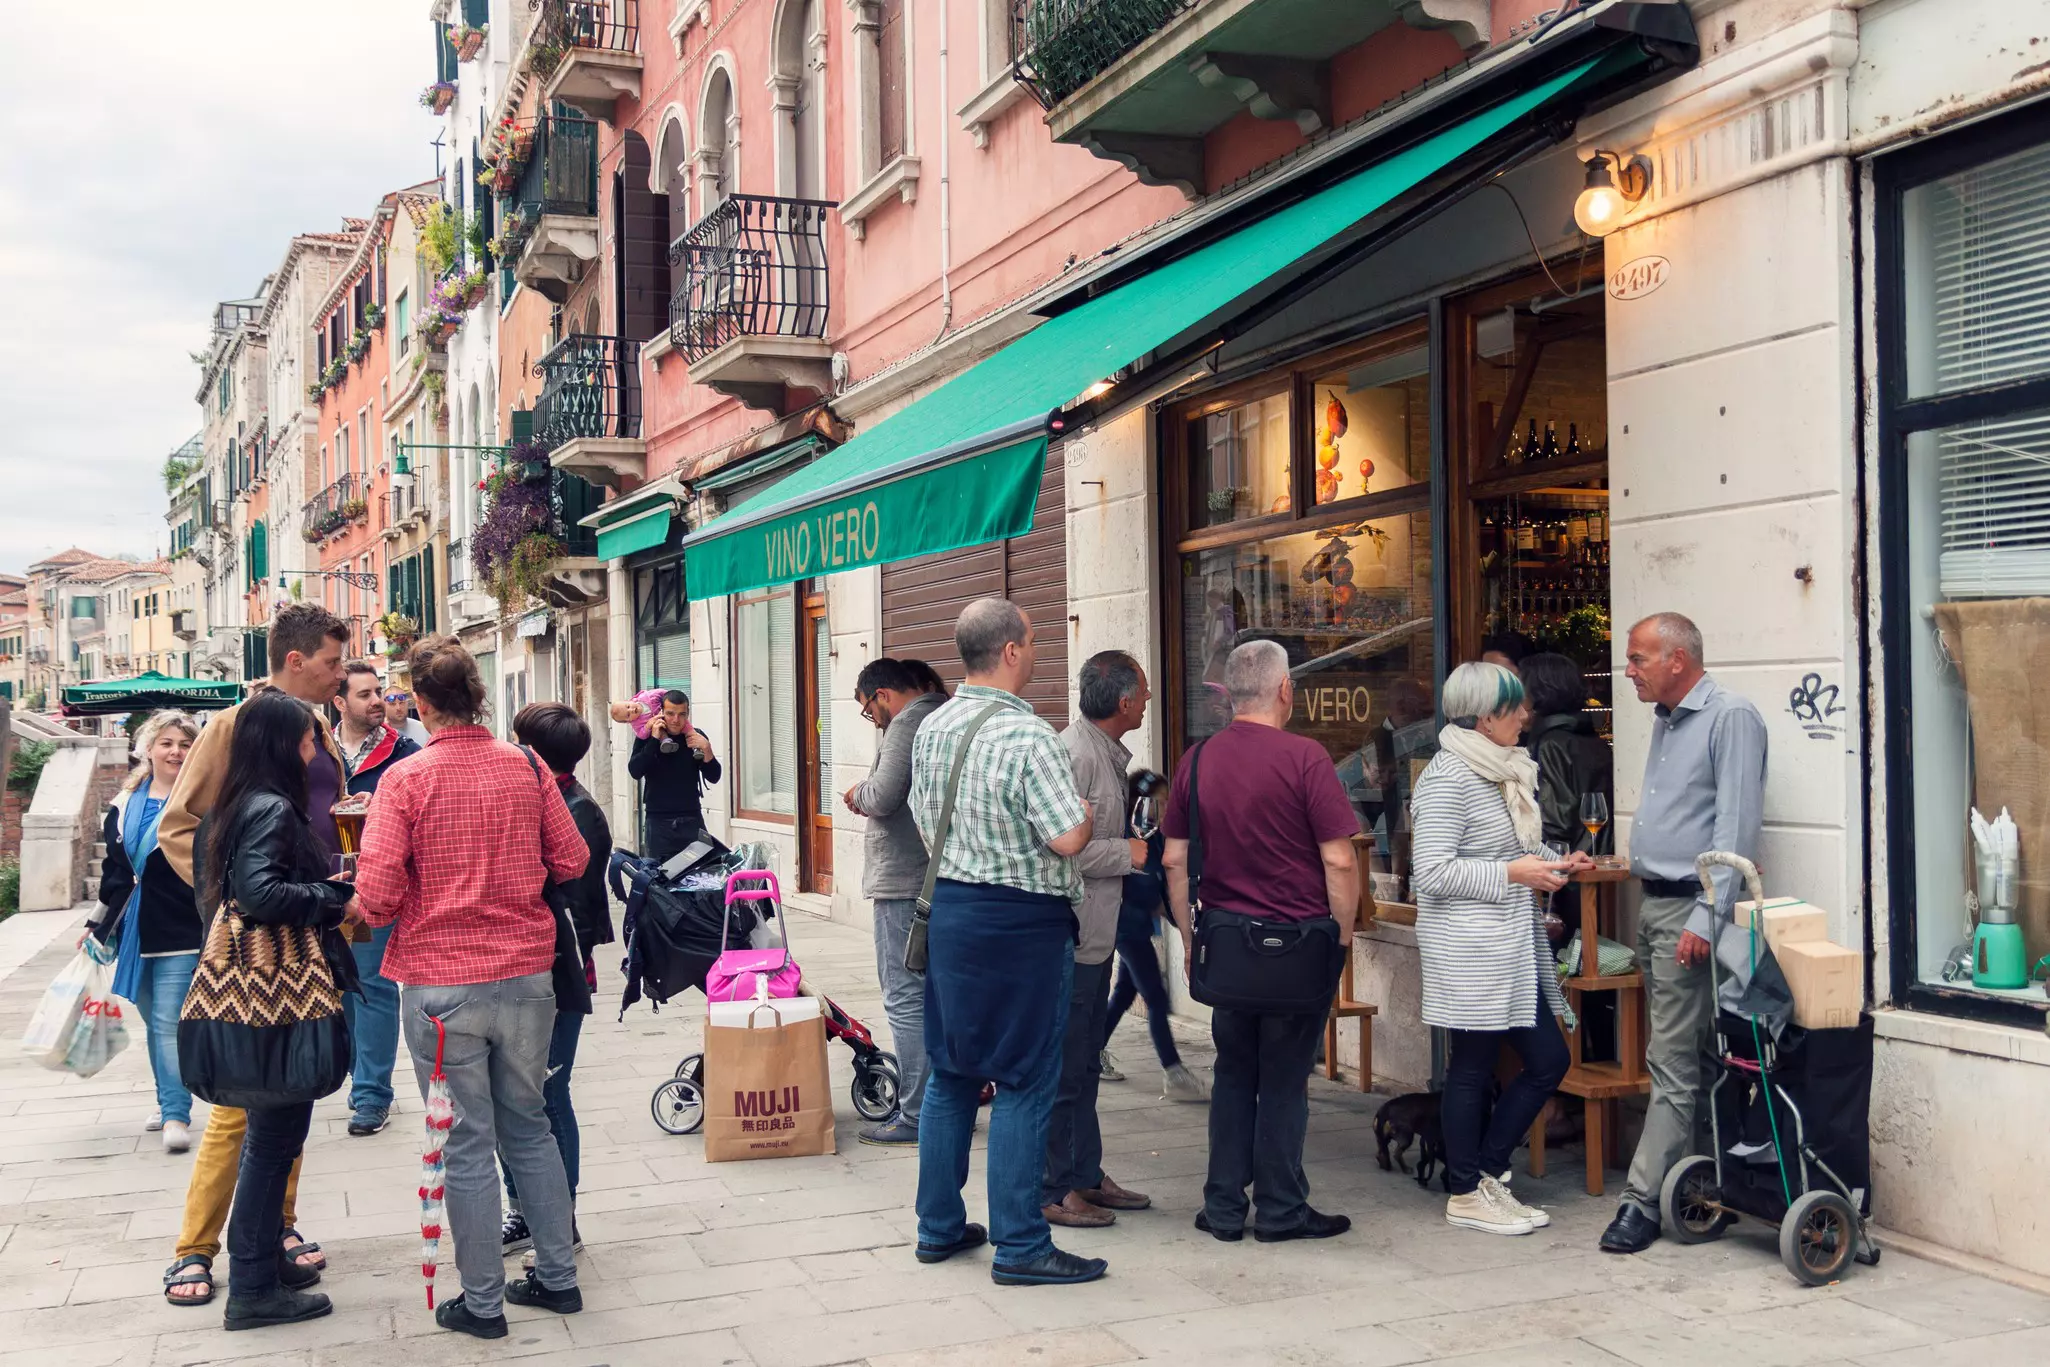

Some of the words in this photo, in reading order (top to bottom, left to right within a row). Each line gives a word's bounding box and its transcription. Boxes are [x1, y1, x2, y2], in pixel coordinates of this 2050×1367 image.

[1614, 260, 1663, 296] 2497
[765, 521, 810, 579] VINO
[817, 501, 879, 568] VERO
[82, 691, 127, 701] Trattoria
[1304, 686, 1370, 722] VERO
[734, 1086, 800, 1117] MUJI
[742, 1116, 795, 1132] 無印良品
[750, 1140, 789, 1149] www.muji.eu
